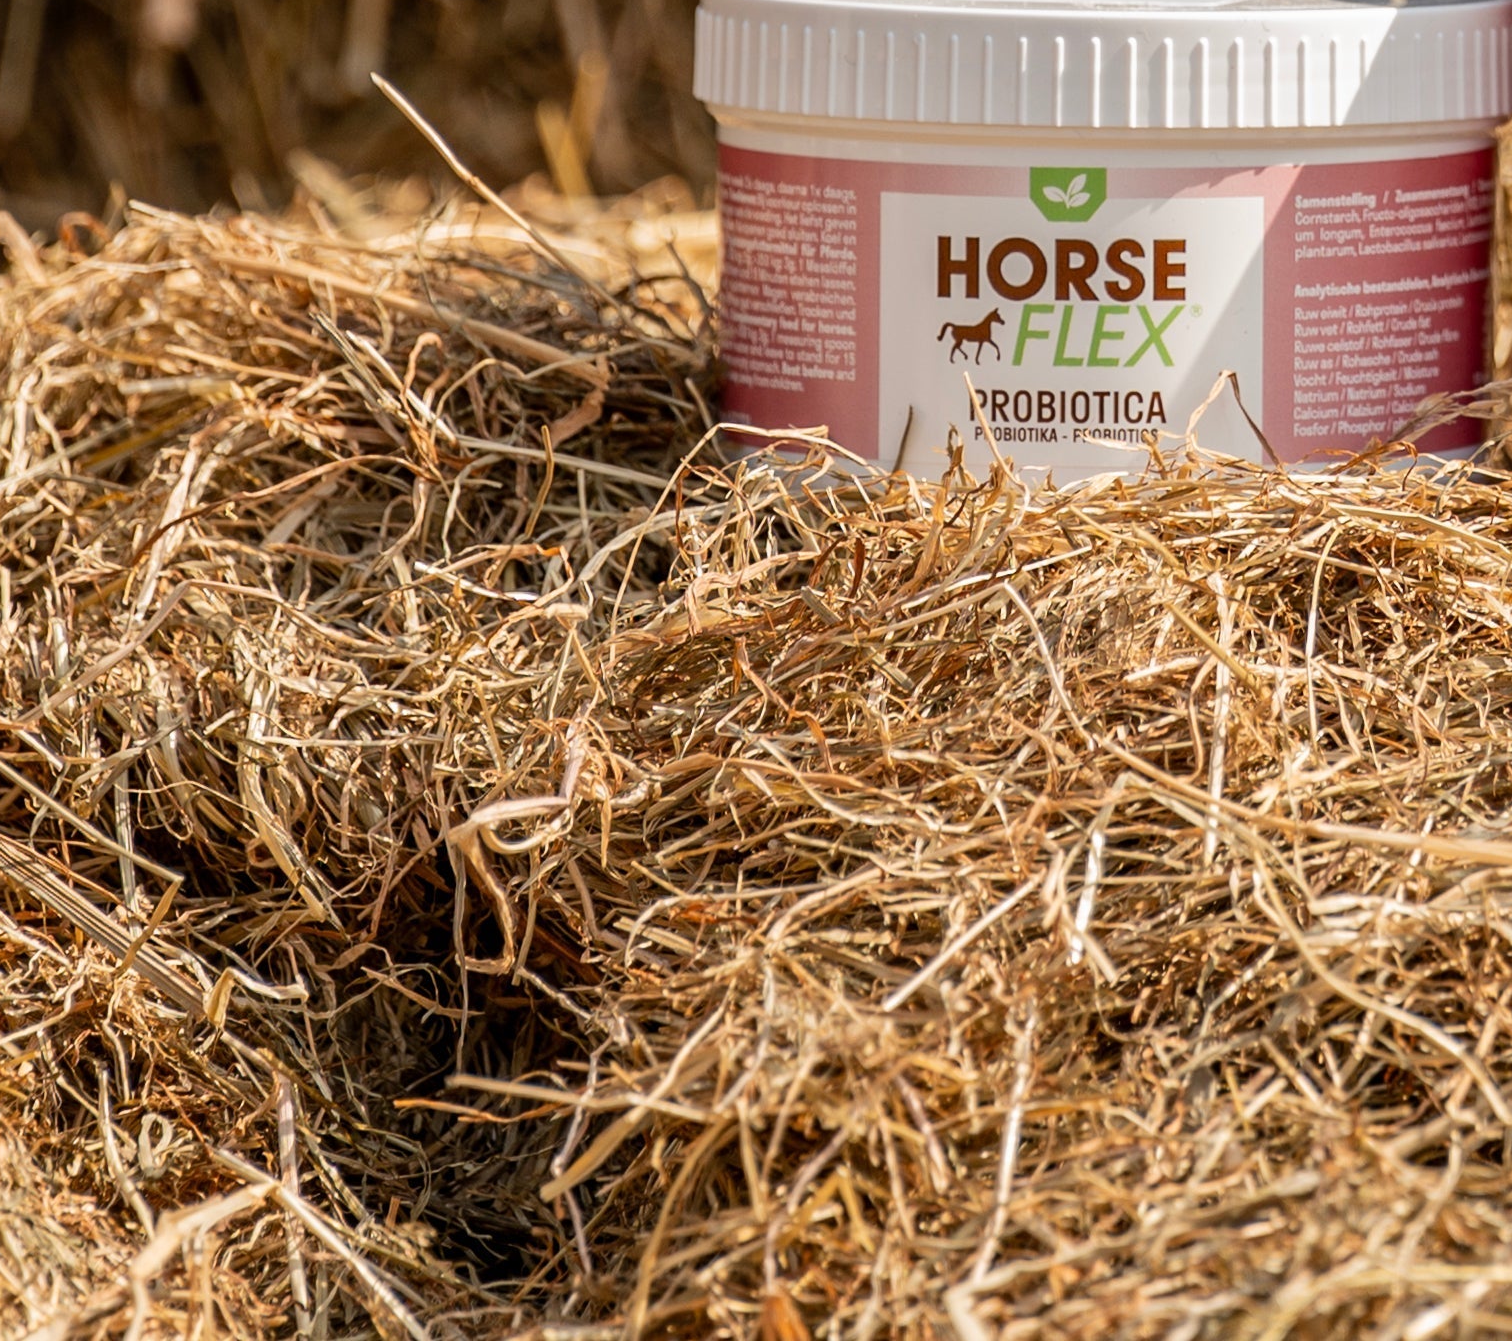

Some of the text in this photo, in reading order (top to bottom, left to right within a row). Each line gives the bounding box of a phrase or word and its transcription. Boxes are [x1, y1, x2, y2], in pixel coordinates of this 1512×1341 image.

[1295, 192, 1377, 209] Samenstelling
[847, 205, 856, 215] in
[1295, 210, 1360, 225] Cornstarch,
[825, 219, 856, 233] geven
[843, 235, 856, 245] en
[1296, 230, 1314, 241] um
[1320, 228, 1364, 243] longum,
[1295, 244, 1357, 262] plantarum,
[937, 236, 1186, 302] HORSE
[1294, 280, 1361, 300] Analytische
[836, 308, 856, 321] und
[1295, 308, 1319, 321] Ruw
[1320, 306, 1347, 319] eiwit
[801, 319, 816, 331] for
[818, 320, 856, 336] horses.
[1012, 303, 1186, 366] FLEX
[1295, 324, 1319, 337] Ruw
[1320, 324, 1338, 336] vet
[1347, 320, 1384, 335] Rohfett
[824, 339, 855, 353] spoon
[1295, 340, 1325, 354] Ruwe
[1327, 337, 1364, 352] celstof
[825, 352, 840, 364] for
[844, 352, 855, 366] 15
[1295, 357, 1319, 370] Ruw
[1321, 359, 1334, 370] as
[836, 369, 856, 381] and
[1294, 374, 1327, 387] Vocht
[1336, 367, 1397, 386] Feuchtigkeit
[1294, 390, 1338, 404] Natrium
[1347, 386, 1386, 401] Natrium
[969, 389, 1167, 424] PROBIOTICA
[1294, 406, 1338, 420] Calcium
[1294, 422, 1329, 437] Fosfor
[1339, 419, 1386, 436] Phosphor
